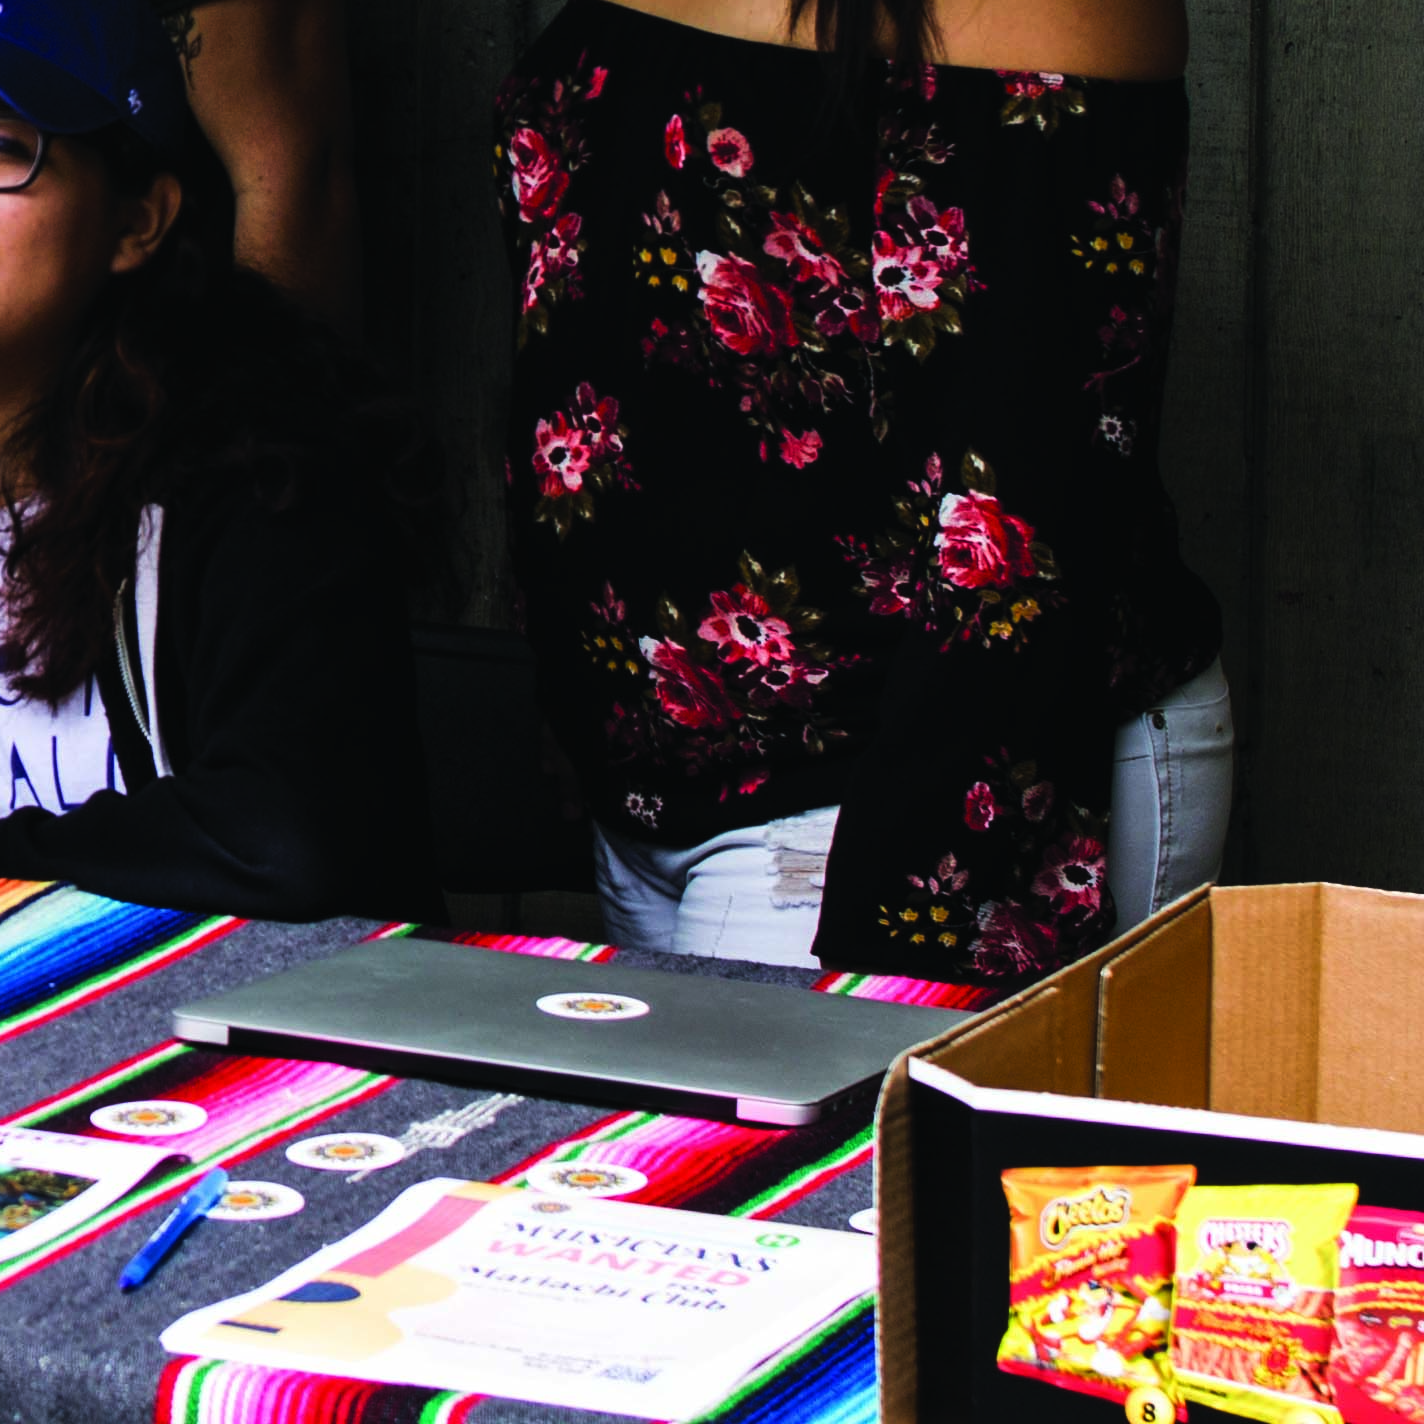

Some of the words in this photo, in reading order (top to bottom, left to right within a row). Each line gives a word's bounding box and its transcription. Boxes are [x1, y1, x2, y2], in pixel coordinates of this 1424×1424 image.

[1046, 1189, 1128, 1245] Cheetos
[488, 1239, 751, 1287] WANTED
[506, 1220, 778, 1273] MUSICIANS
[462, 1264, 632, 1299] Mariachi
[639, 1289, 728, 1312] Club
[666, 1281, 717, 1296] FOR
[1142, 1403, 1156, 1422] 8
